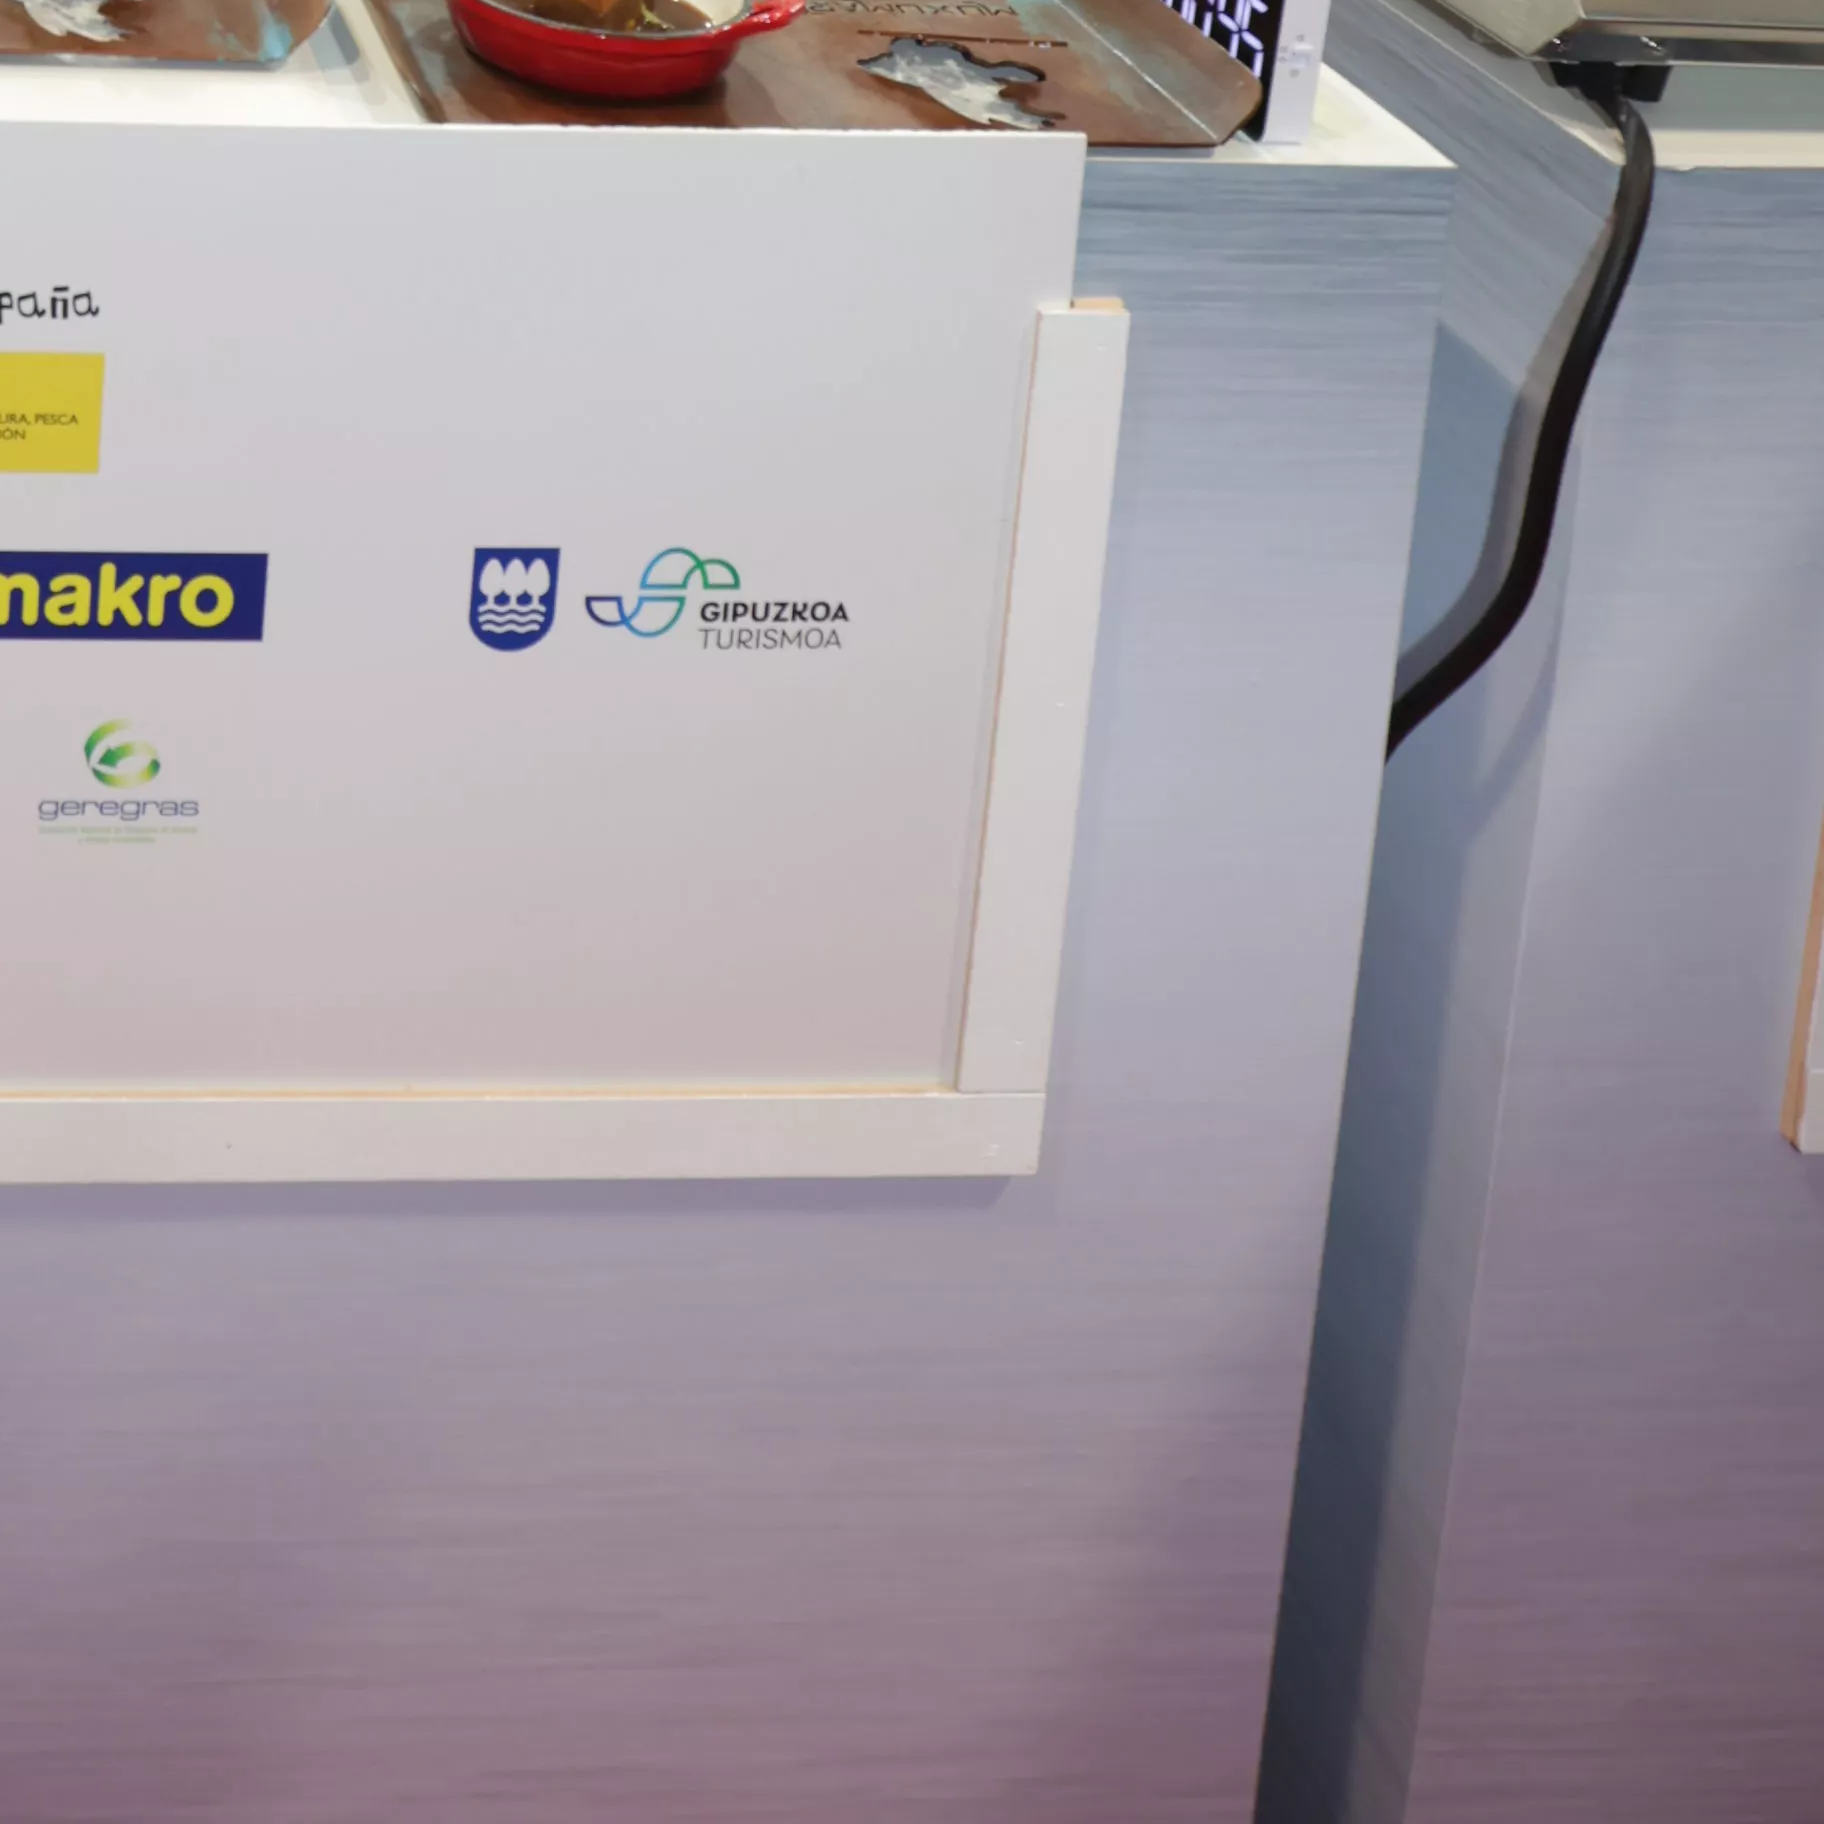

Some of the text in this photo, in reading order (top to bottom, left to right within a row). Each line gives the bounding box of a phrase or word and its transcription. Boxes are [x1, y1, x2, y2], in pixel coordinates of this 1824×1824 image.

[34, 413, 79, 426] PESCA
[699, 600, 849, 623] GIPUZKOA
[698, 627, 842, 650] TURISMOA
[37, 799, 200, 823] geregras
